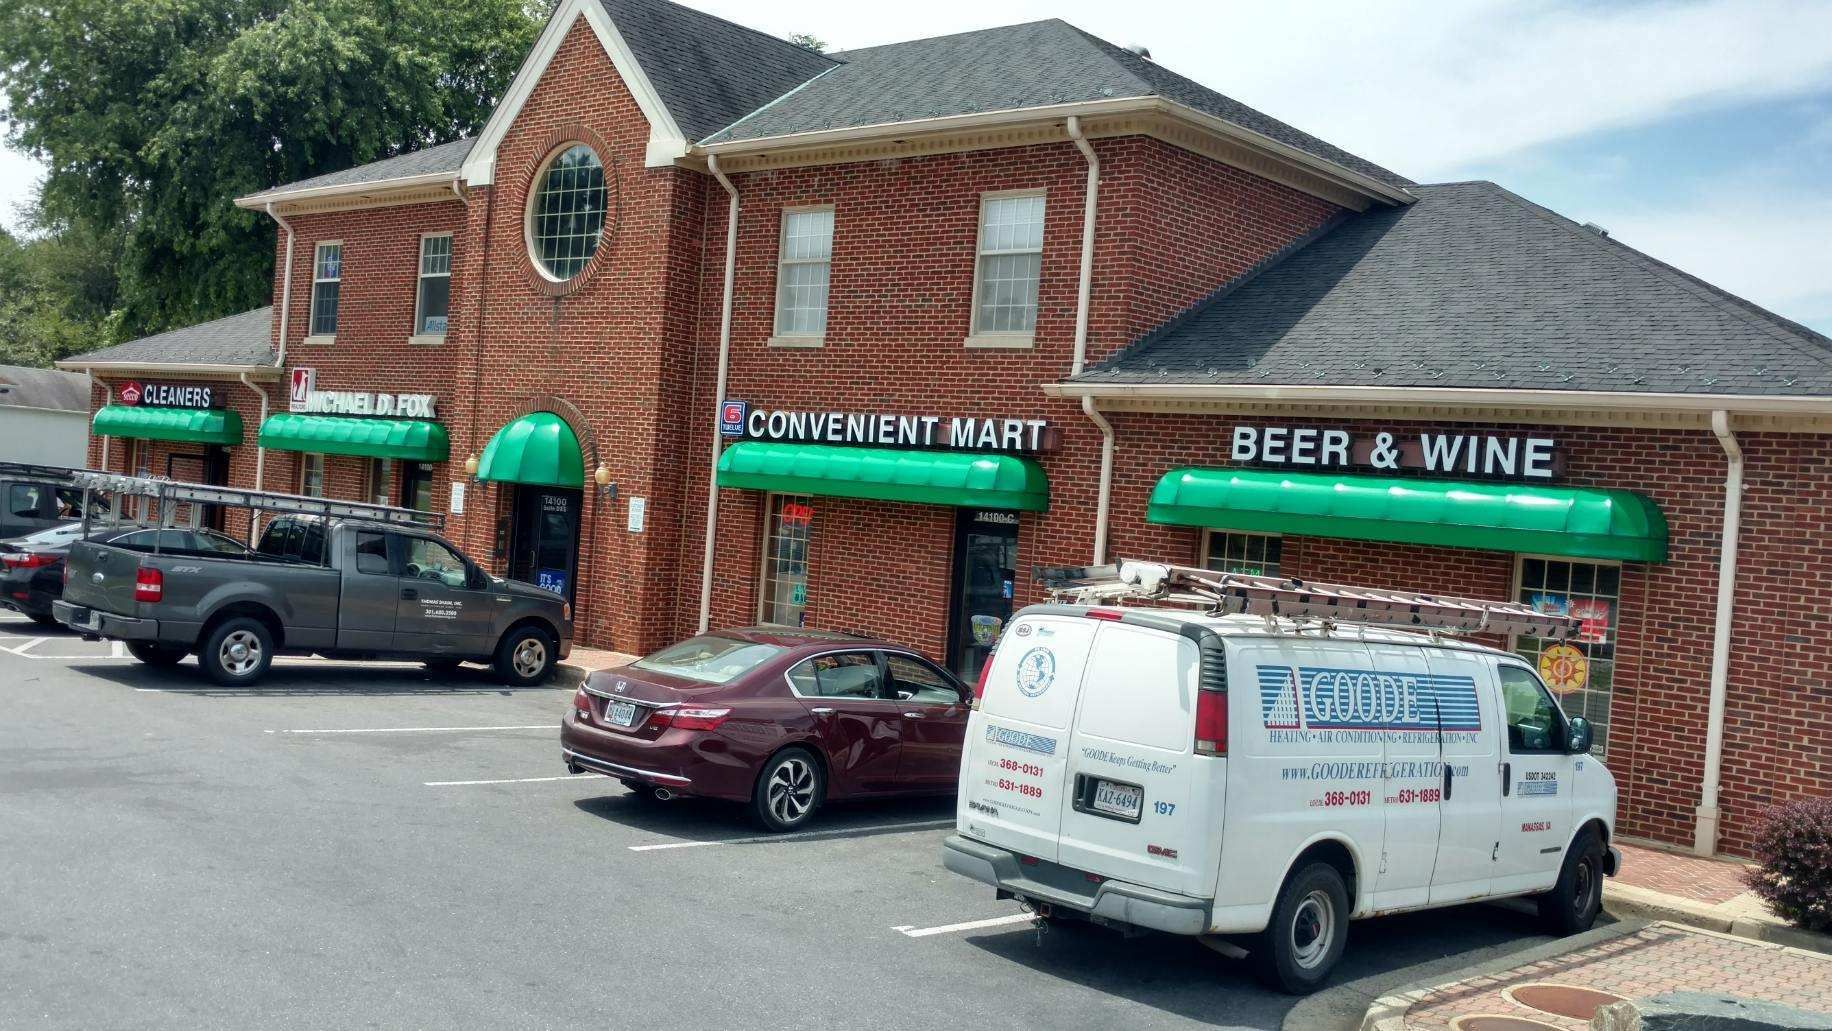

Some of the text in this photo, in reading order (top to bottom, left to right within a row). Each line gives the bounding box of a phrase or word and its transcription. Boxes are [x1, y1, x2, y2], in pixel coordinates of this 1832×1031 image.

[144, 384, 211, 408] CLEANERS
[308, 391, 372, 415] MICHAEL
[397, 394, 433, 417] FOX
[724, 404, 742, 424] 6
[749, 410, 1047, 450] CONVENIENT MART
[1231, 426, 1554, 477] BEER & WINE
[545, 497, 567, 505] 14100
[1310, 672, 1420, 722] GOODE
[1270, 731, 1311, 743] HEATING
[1317, 731, 1332, 743] AIR
[1335, 731, 1397, 744] CONDITIONING
[1000, 758, 1044, 778] 368-0131
[1109, 752, 1126, 767] Keeps
[1126, 756, 1151, 773] Getting
[1575, 762, 1584, 772] 197
[998, 779, 1042, 798] 631-1889
[1325, 789, 1371, 806] 368-0131
[1399, 789, 1440, 804] 631-1889
[1097, 788, 1137, 810] KAZ-6494
[1154, 800, 1176, 816] 197
[1147, 844, 1178, 859] GMC
